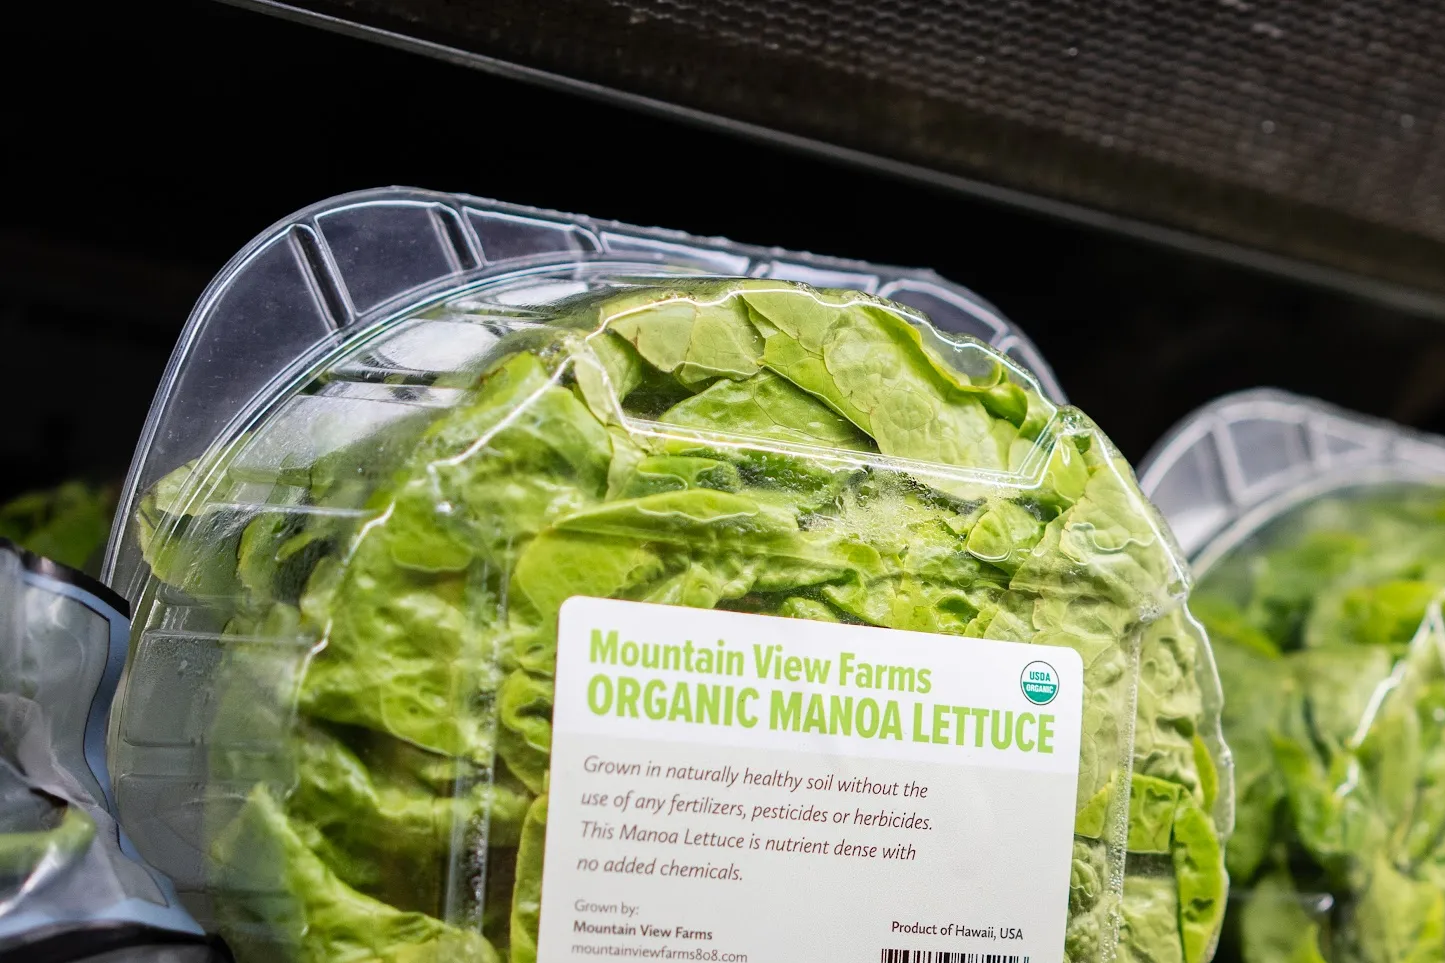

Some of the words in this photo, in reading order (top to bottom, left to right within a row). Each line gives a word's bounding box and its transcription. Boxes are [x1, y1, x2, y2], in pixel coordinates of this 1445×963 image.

[590, 629, 744, 679] Mountain
[754, 645, 831, 684] View
[840, 652, 931, 693] Farms
[1029, 670, 1051, 682] USDA
[1026, 683, 1054, 694] ORGANIC
[588, 674, 759, 728] ORGANIC
[770, 690, 902, 740] MANOA
[913, 702, 1054, 753] LETTUCE
[584, 755, 640, 775] Grown
[646, 761, 661, 777] in
[665, 763, 740, 788] naturally
[743, 767, 803, 793] healthy
[806, 774, 834, 790] soil
[838, 777, 899, 796] without
[904, 780, 928, 798] the
[580, 793, 608, 807] use
[614, 790, 634, 812] of
[635, 797, 666, 814] any
[668, 794, 746, 819] fertilizers,
[751, 804, 828, 822] pesticides
[833, 812, 850, 824] or
[854, 809, 932, 830] herbicides.
[582, 821, 614, 839] This
[619, 824, 678, 844] Manoa
[684, 828, 744, 848] Lettuce
[749, 833, 760, 849] is
[765, 837, 830, 854] nutrient
[834, 838, 877, 858] dense
[883, 843, 916, 860] with
[576, 858, 600, 872] no
[604, 856, 657, 875] added
[660, 859, 744, 880] chemicals.
[575, 899, 617, 913] Grown
[621, 901, 640, 918] by:
[574, 920, 636, 935] Mountain
[640, 925, 671, 937] View
[675, 926, 712, 940] Farms
[892, 921, 938, 936] Product
[940, 923, 954, 936] of
[955, 925, 996, 941] Hawaii,
[1000, 928, 1023, 940] USA
[571, 941, 748, 963] mountainviewfarms808.com
